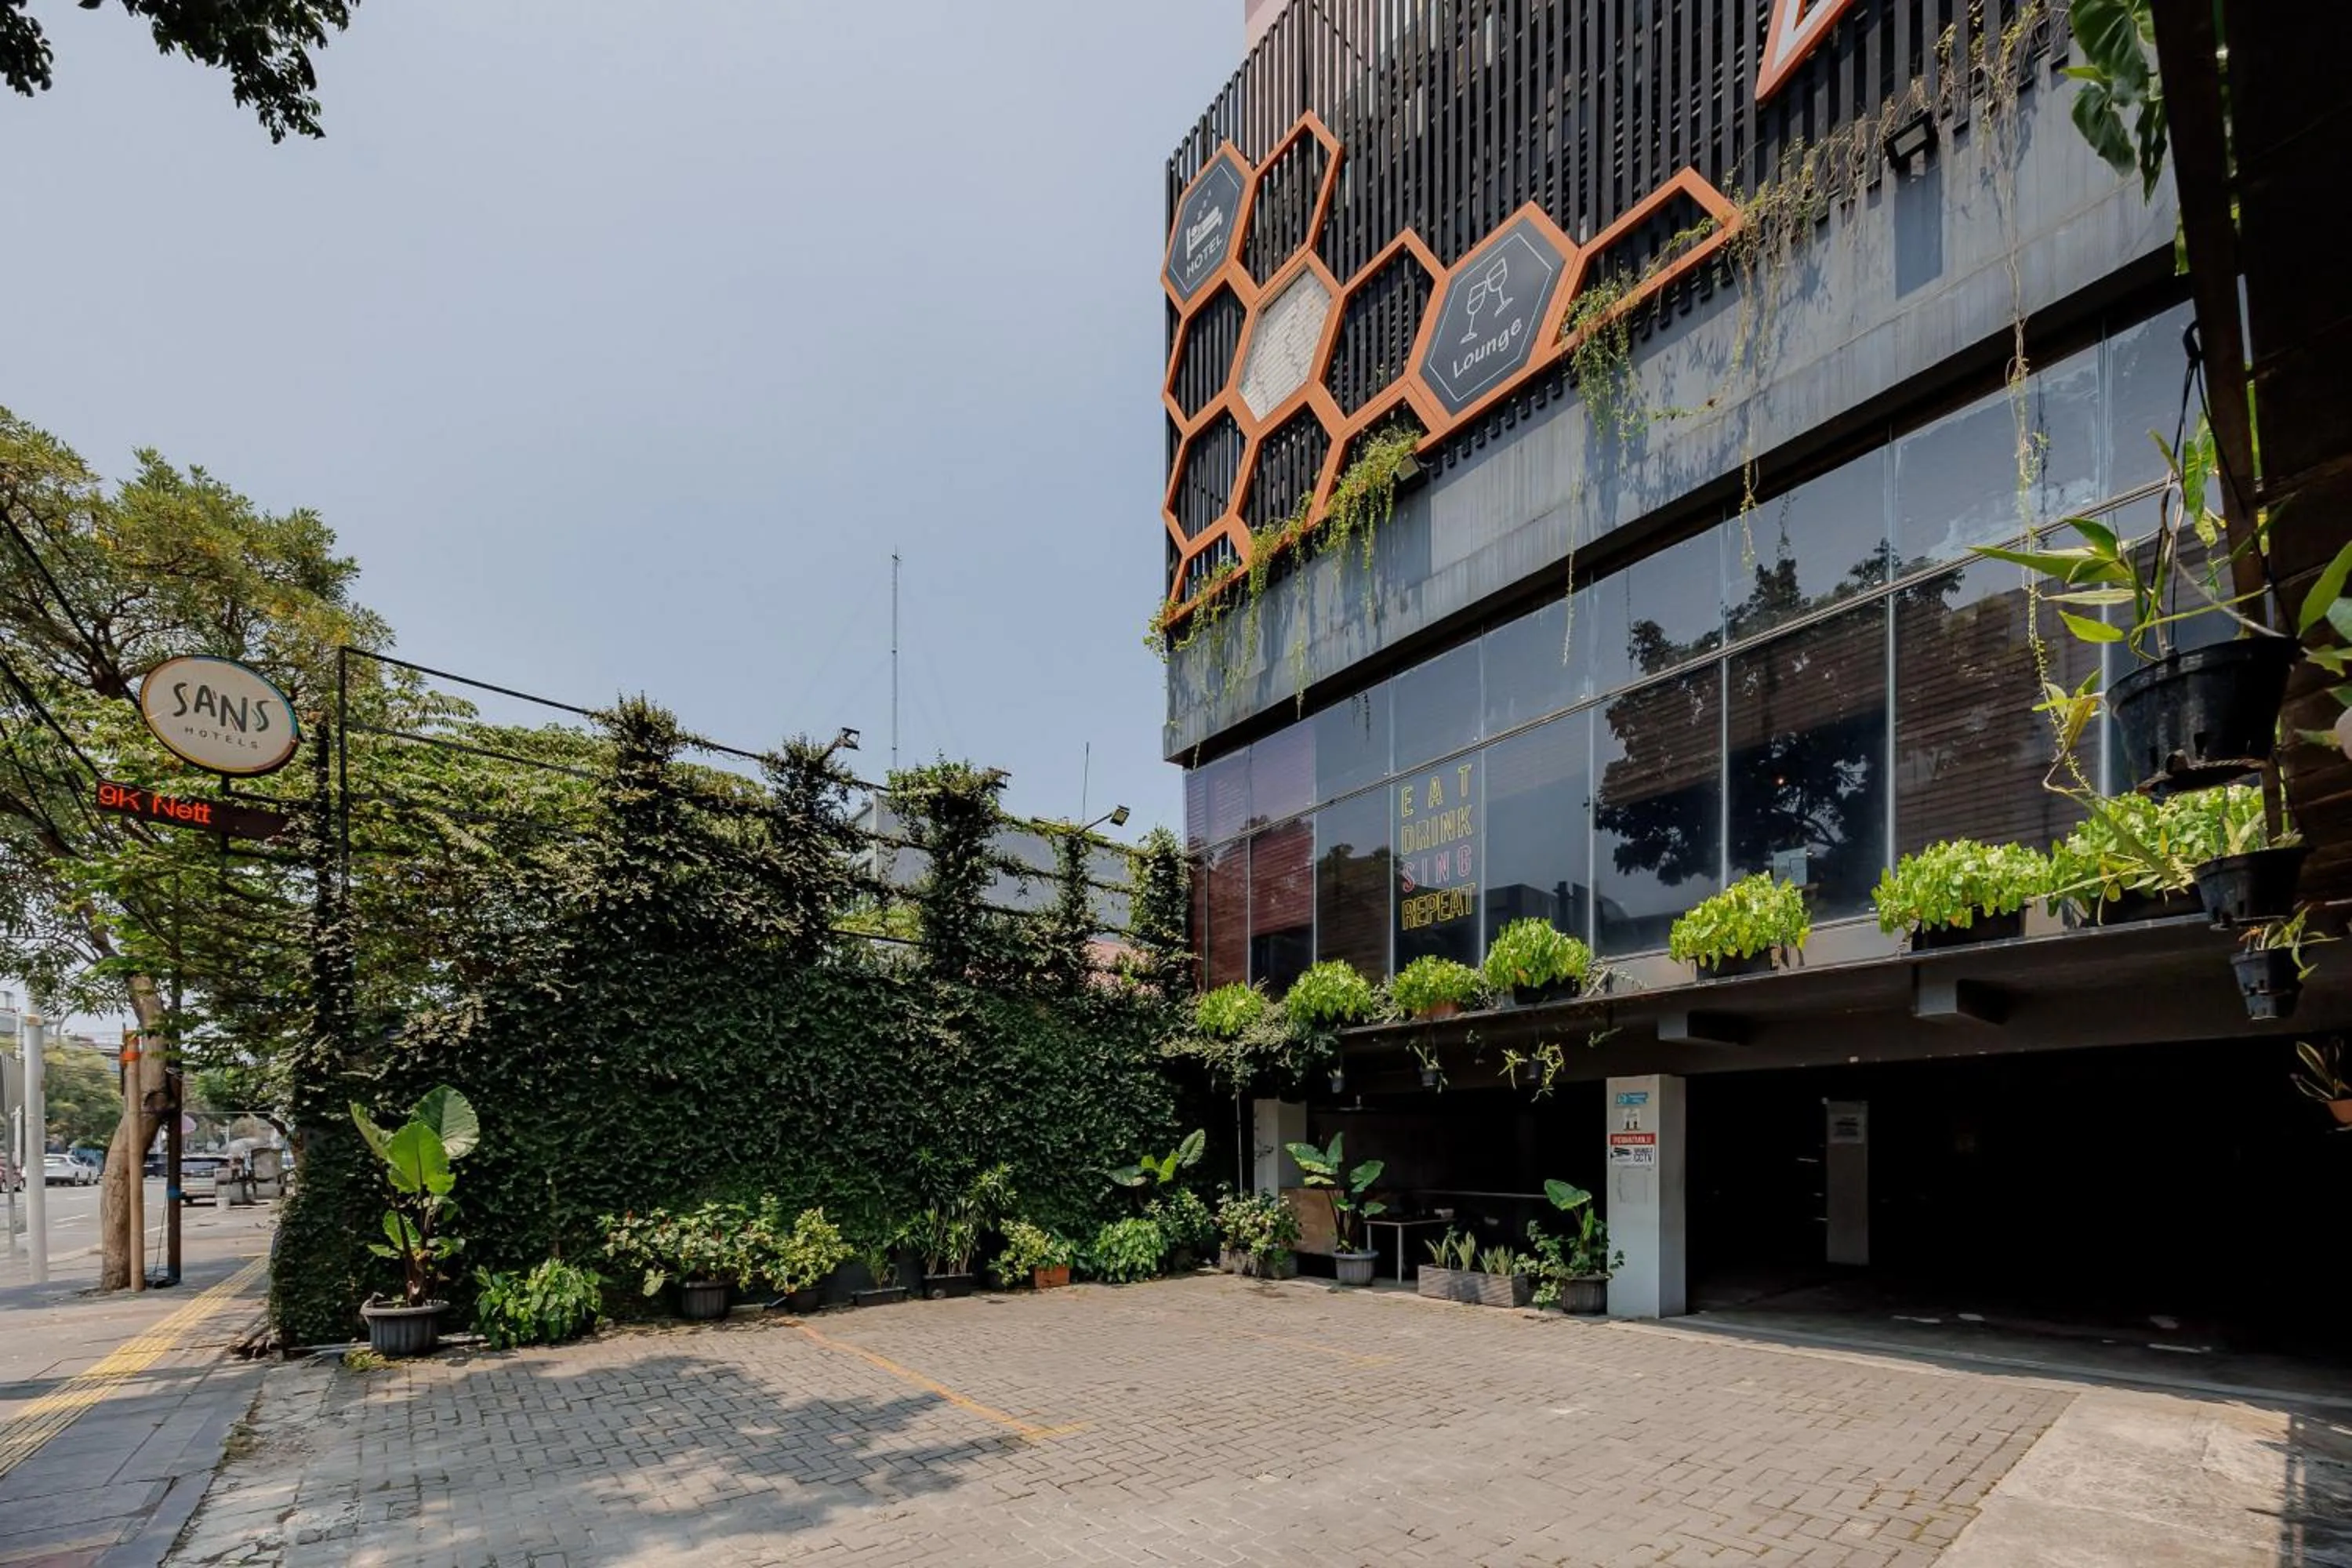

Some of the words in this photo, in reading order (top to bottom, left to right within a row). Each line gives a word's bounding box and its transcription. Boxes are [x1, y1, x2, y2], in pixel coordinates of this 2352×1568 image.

[1186, 234, 1222, 278] HOTEL
[1453, 318, 1523, 378] Lounge
[173, 682, 270, 732] SANS
[184, 726, 260, 750] HOTELS
[153, 793, 212, 825] Nett
[1401, 764, 1472, 817] EAT
[1401, 804, 1473, 855] DRINK
[1402, 844, 1472, 894] SING
[1401, 882, 1477, 931] REPEAT
